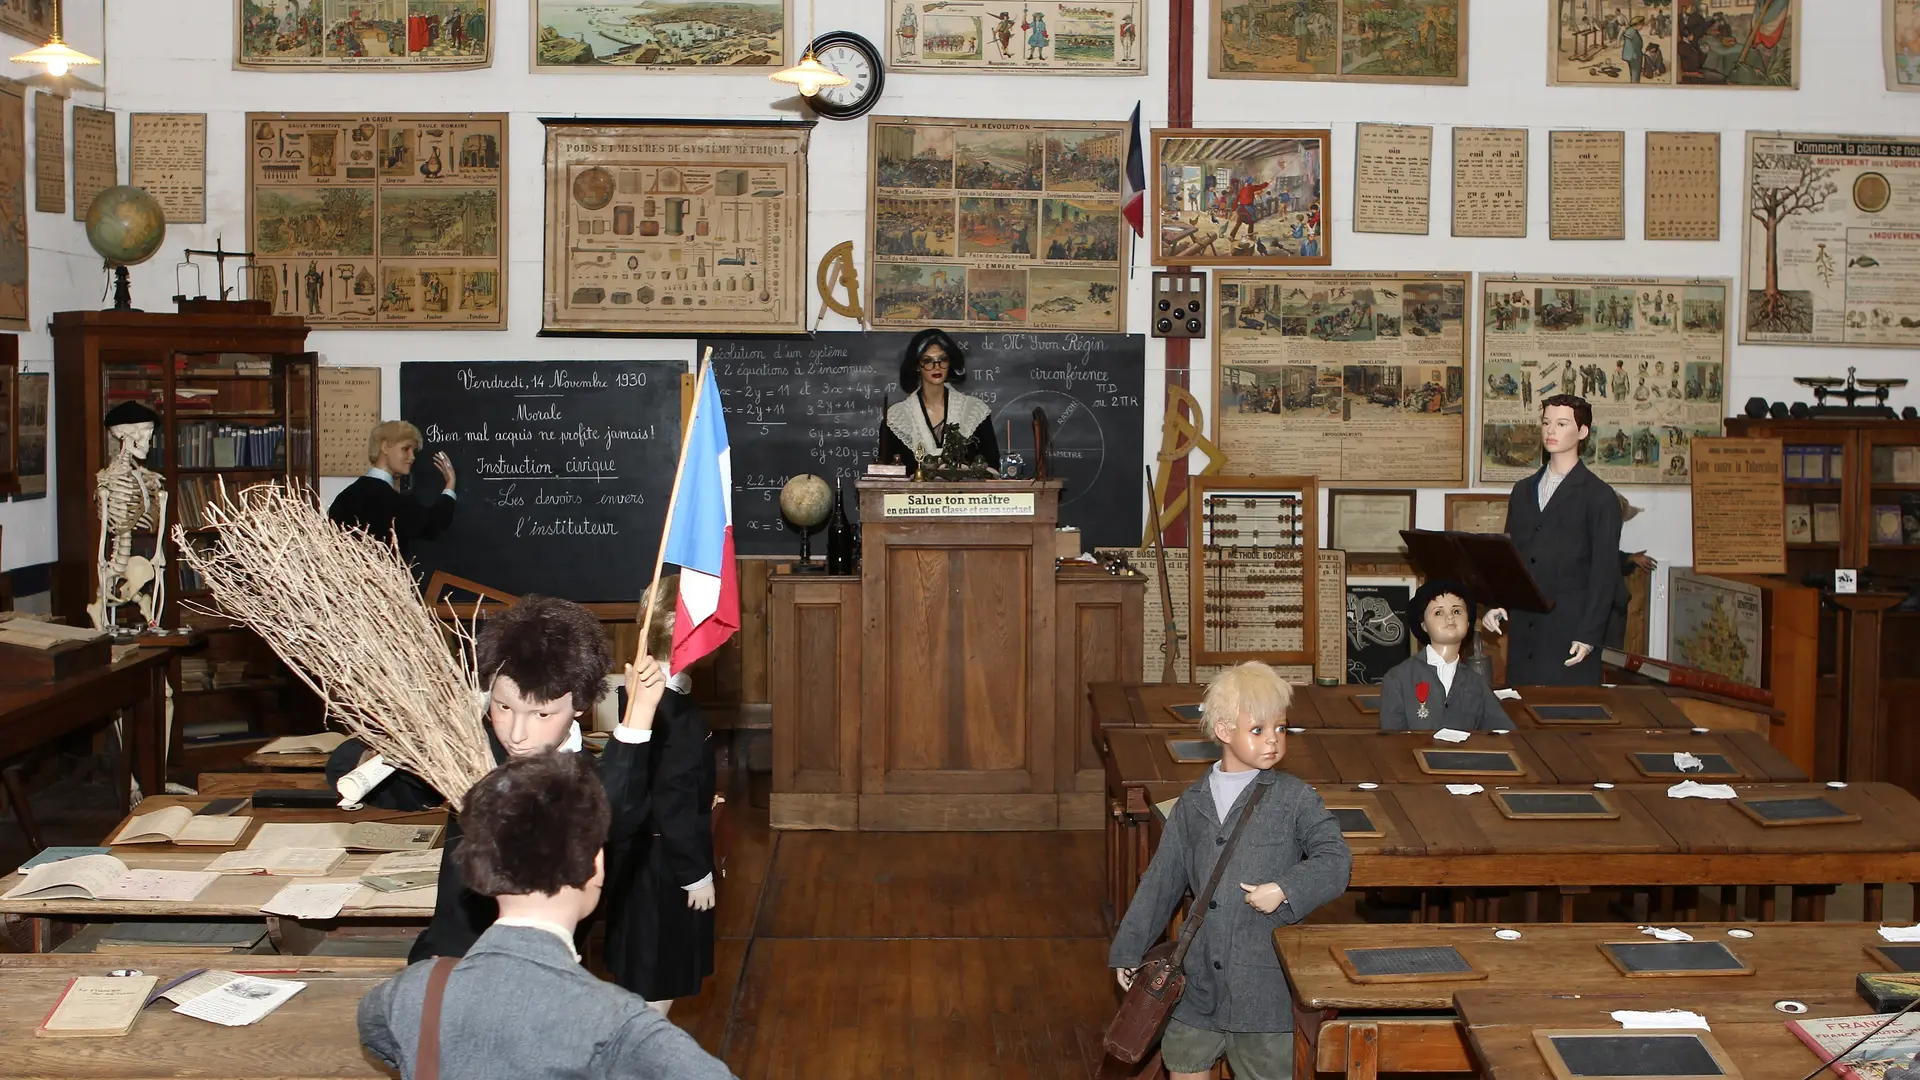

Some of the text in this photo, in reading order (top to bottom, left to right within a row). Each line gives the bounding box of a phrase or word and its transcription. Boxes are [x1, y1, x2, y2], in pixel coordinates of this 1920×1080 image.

[566, 144, 598, 153] POIDS
[601, 144, 613, 153] ET
[617, 144, 665, 153] MESURES
[1796, 141, 1845, 154] Comment
[1846, 144, 1855, 154] la
[1857, 145, 1888, 156] plante
[1891, 147, 1901, 156] se
[1816, 159, 1869, 167] MOUVEMENT
[773, 344, 802, 359] d'un
[808, 346, 848, 365] système
[981, 335, 995, 349] de
[1062, 333, 1109, 365] Régin
[457, 368, 647, 391] Vendredi, 14 Novembre 1930
[724, 368, 733, 376] 2
[736, 363, 789, 384] équations
[794, 363, 804, 376] à
[807, 367, 816, 375] 2
[1030, 362, 1110, 390] circonférence
[1092, 397, 1107, 408] ou
[511, 403, 562, 421] Morale
[1056, 399, 1079, 426] RAYON
[426, 424, 460, 444] Bien
[466, 422, 489, 441] mal
[495, 428, 533, 448] acquis
[538, 430, 556, 441] ne
[560, 426, 600, 448] profite
[760, 426, 769, 435] 5
[475, 455, 616, 484] Instruction civique
[498, 482, 645, 507] Les devoirs envers
[763, 491, 771, 501] 5
[908, 494, 1010, 505] Salue ton maître
[898, 507, 929, 515] entrant
[942, 506, 968, 514] Classe
[969, 506, 978, 514] et
[1002, 506, 1032, 514] sortant
[514, 515, 619, 538] l'instituteur
[775, 518, 784, 530] 3
[1263, 552, 1295, 560] BOSCHER
[1825, 1020, 1904, 1031] FRANCE
